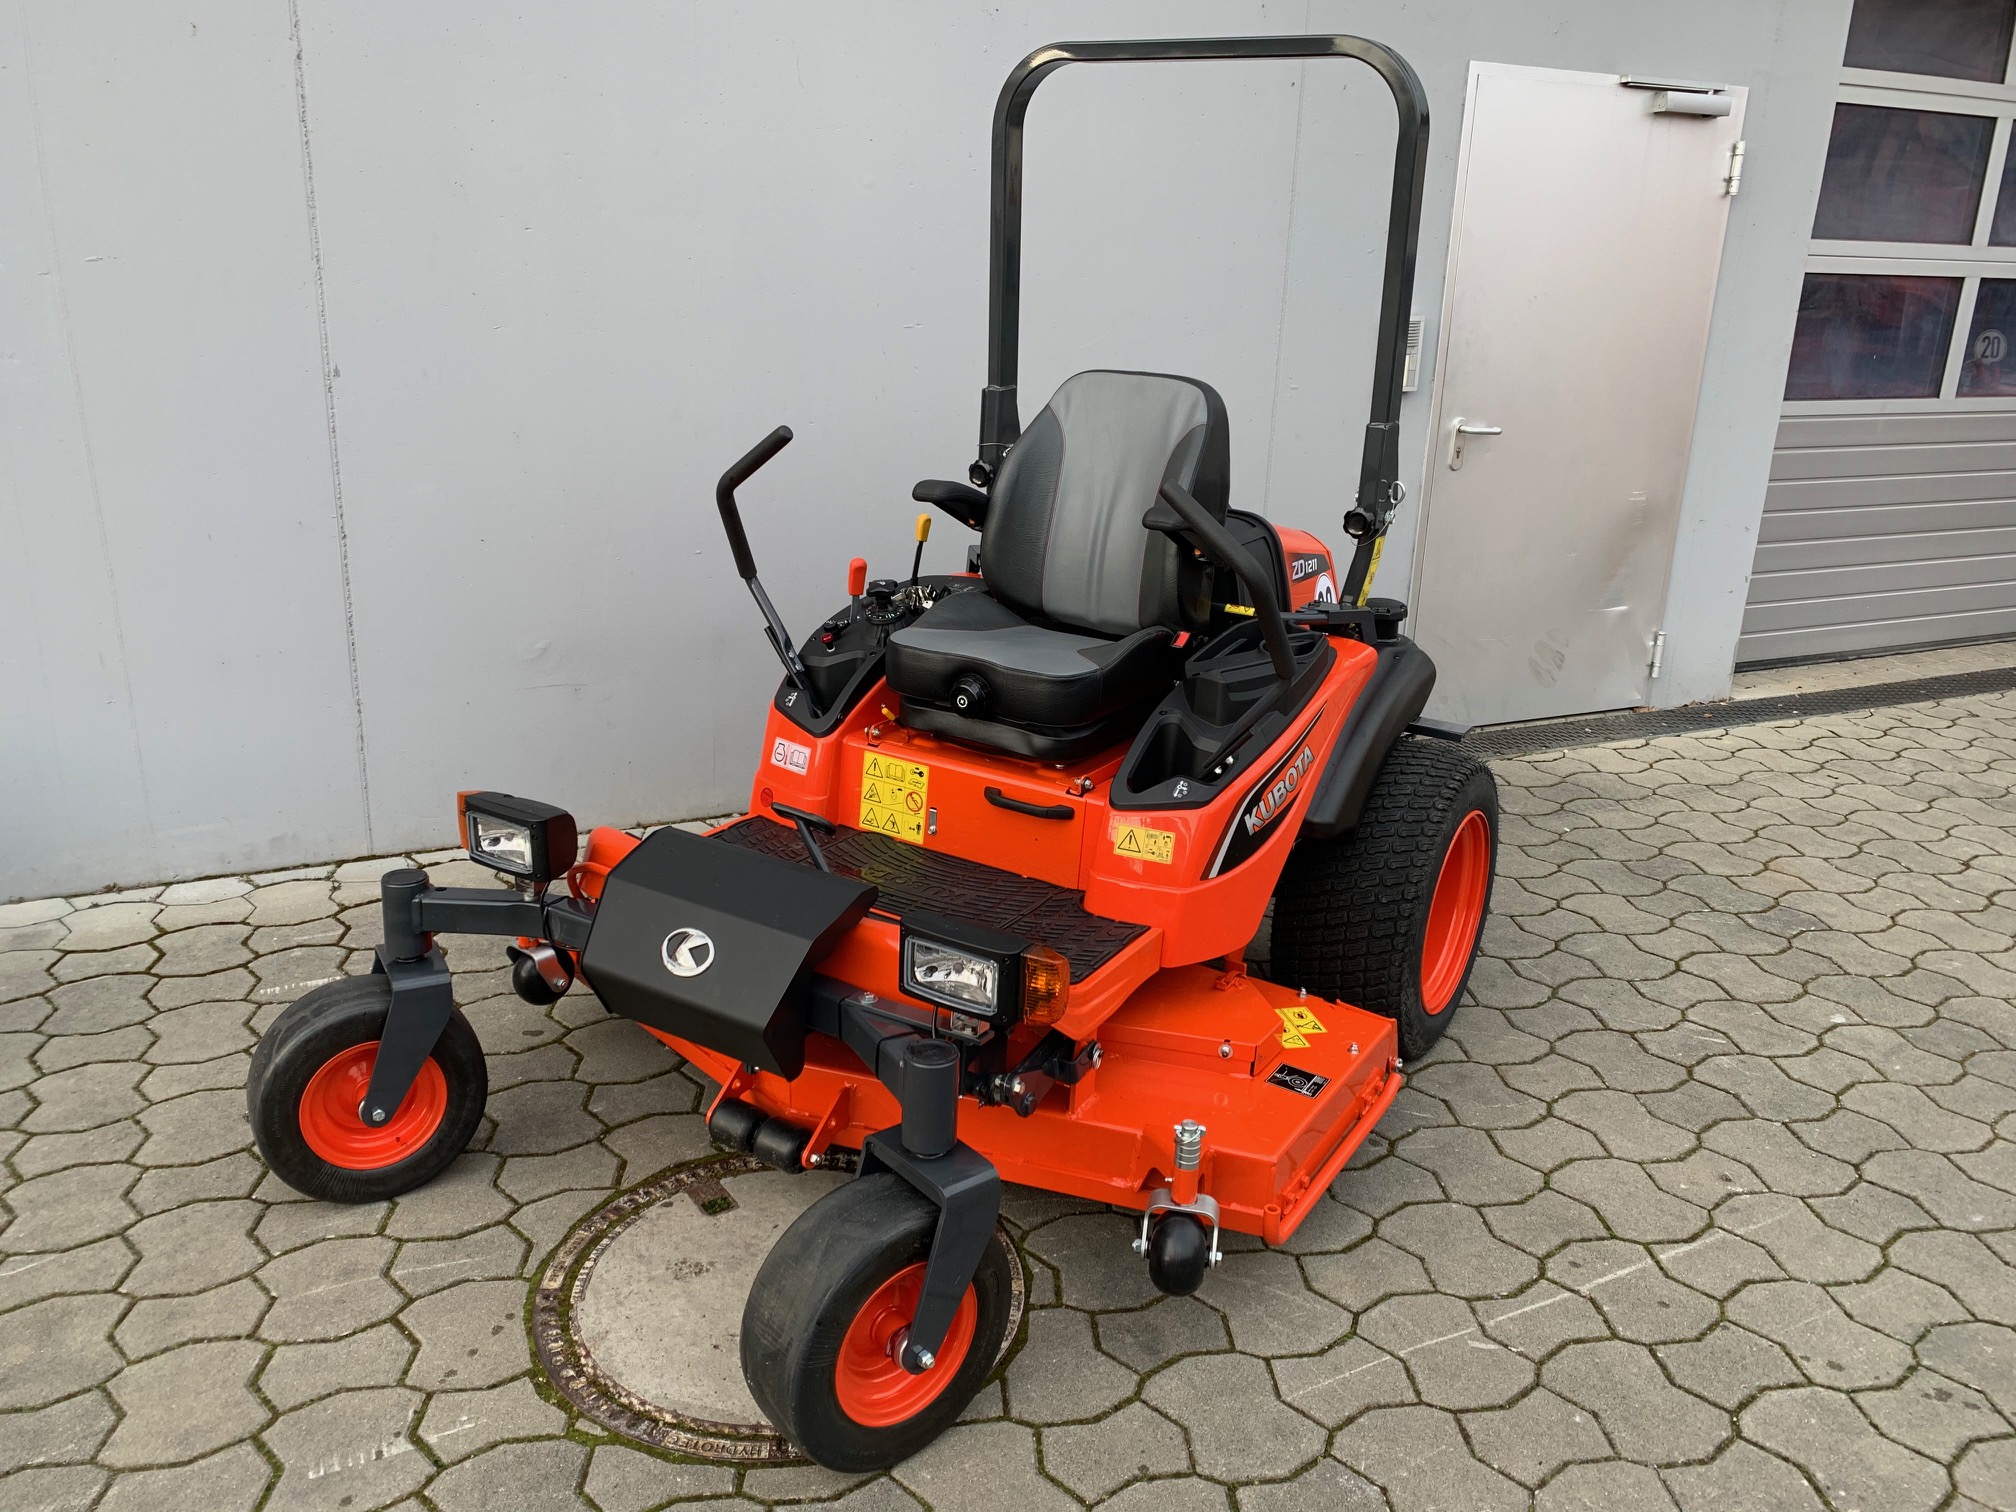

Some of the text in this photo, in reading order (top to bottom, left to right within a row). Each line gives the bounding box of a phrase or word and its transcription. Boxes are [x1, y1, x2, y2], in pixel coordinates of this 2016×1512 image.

[1981, 335, 2000, 359] 20
[1244, 745, 1315, 837] KUBOTA
[665, 1434, 763, 1459] HYDROTEC
